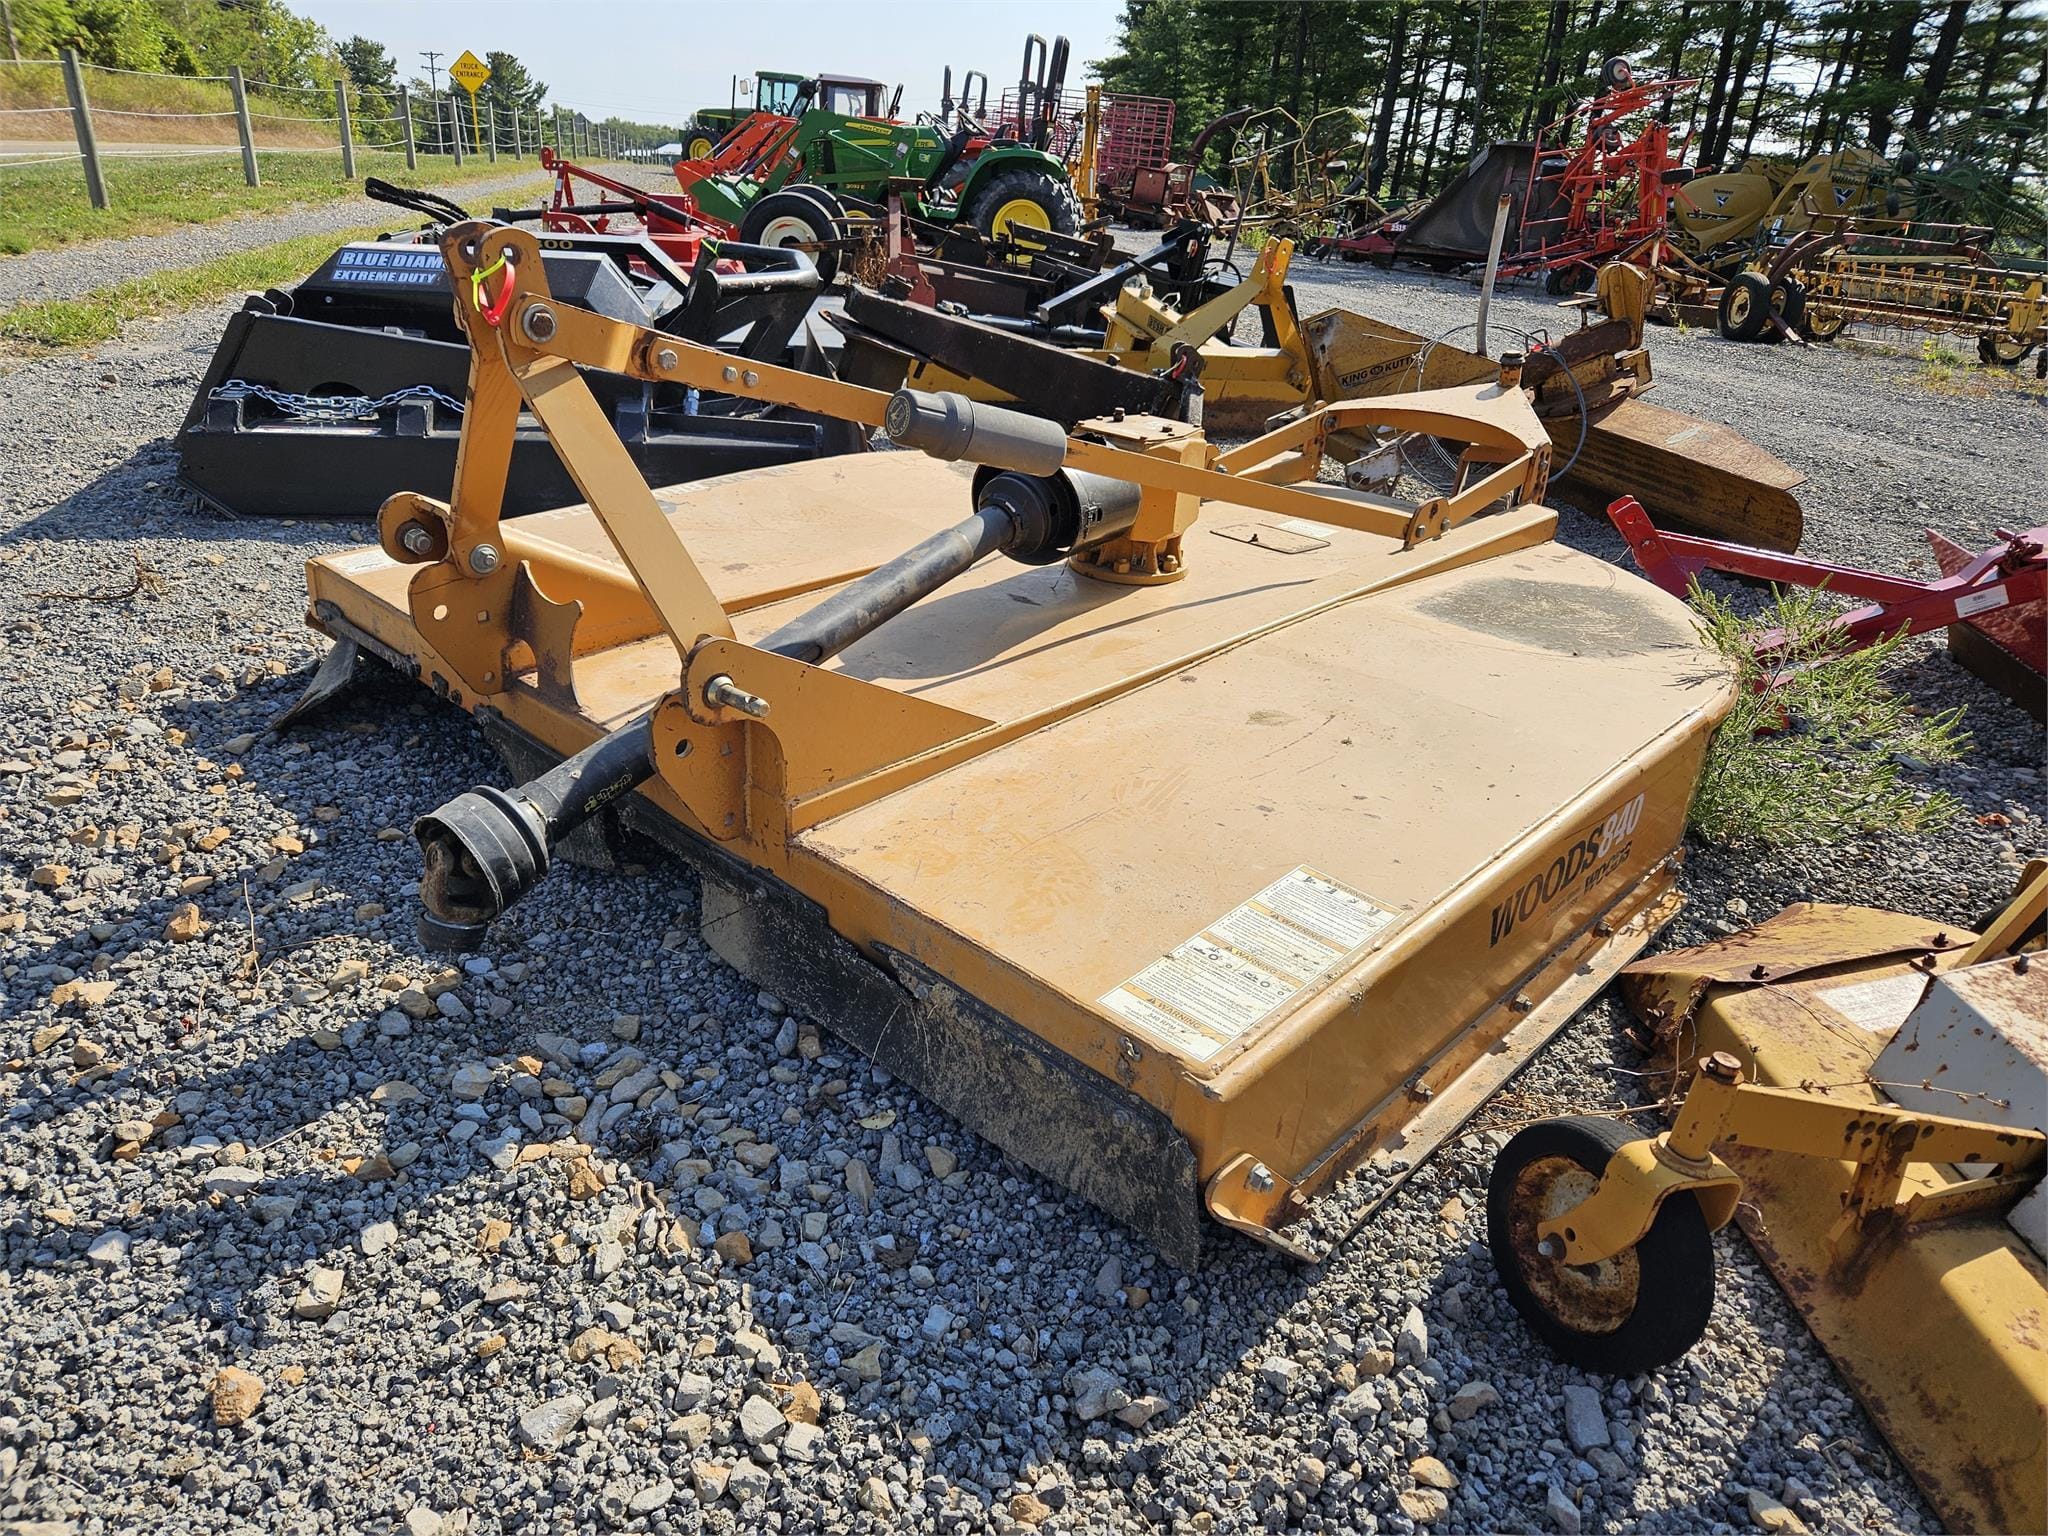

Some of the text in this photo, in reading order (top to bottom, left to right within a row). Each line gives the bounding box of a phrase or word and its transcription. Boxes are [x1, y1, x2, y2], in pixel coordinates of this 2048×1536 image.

[456, 71, 484, 79] ENTRANCE
[339, 251, 447, 269] BLUE DIAM
[332, 270, 438, 284] EXTREME DUTY
[1341, 370, 1368, 385] KING
[1489, 823, 1604, 948] WOODS
[1597, 793, 1646, 858] 840
[1334, 882, 1376, 903] WARNING
[1280, 918, 1324, 941] WARNING
[1232, 950, 1278, 975] WARNING
[1155, 1002, 1202, 1029] WARNING
